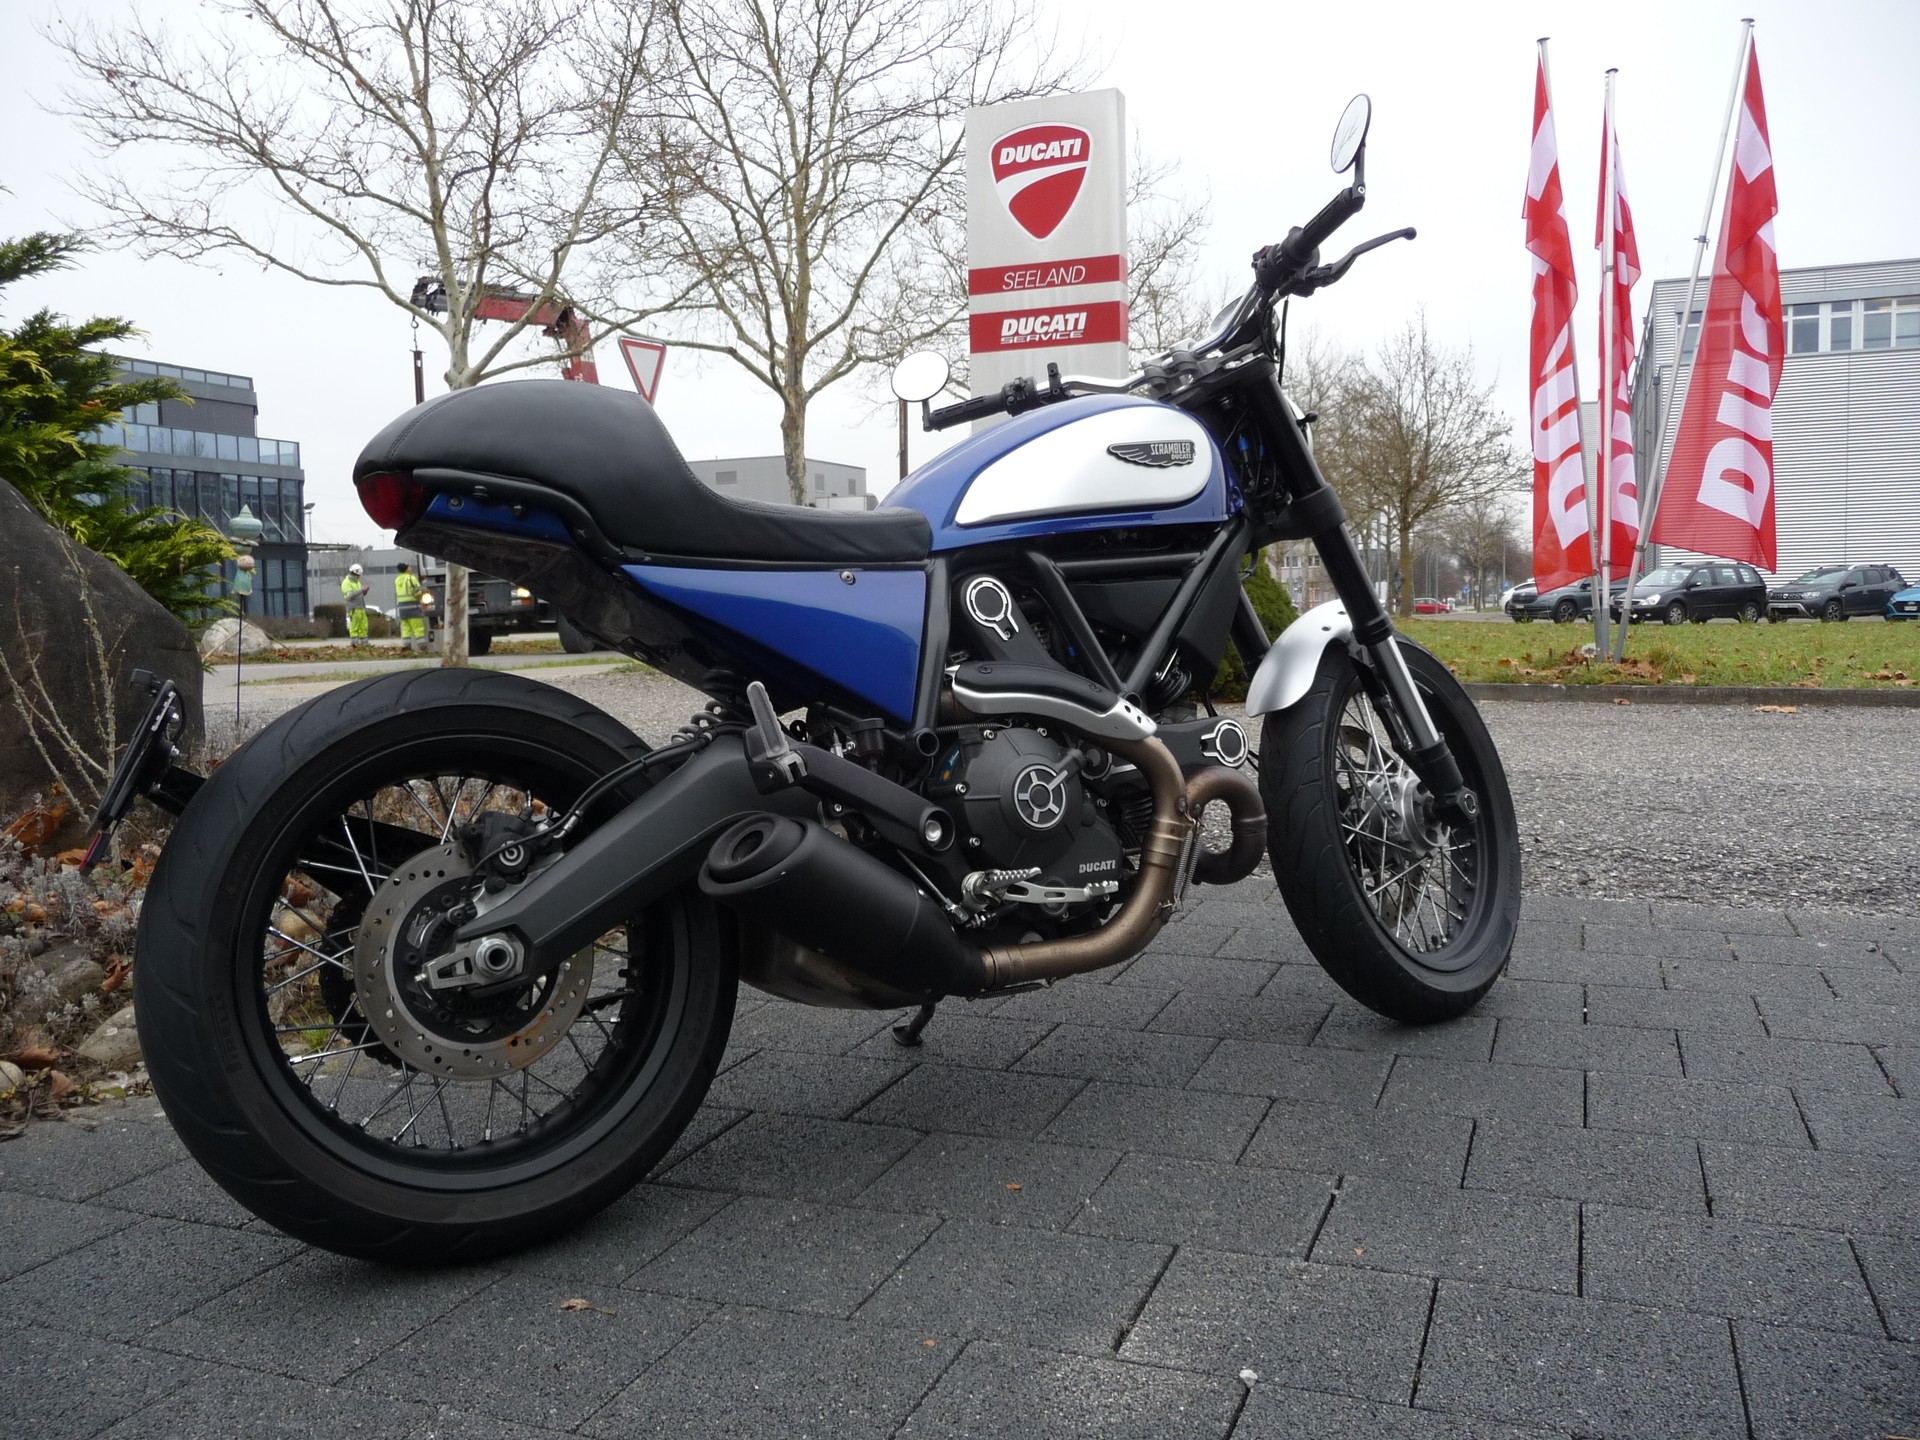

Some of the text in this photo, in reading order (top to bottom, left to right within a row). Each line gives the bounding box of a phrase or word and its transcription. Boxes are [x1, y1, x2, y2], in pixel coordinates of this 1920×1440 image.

[999, 138, 1082, 166] DUCATI
[1002, 265, 1086, 290] SEELAND
[1001, 312, 1087, 336] DUCATI
[1000, 330, 1084, 345] SERVICE
[1150, 443, 1191, 455] SCRAMBLER
[1079, 860, 1116, 874] DUCATI
